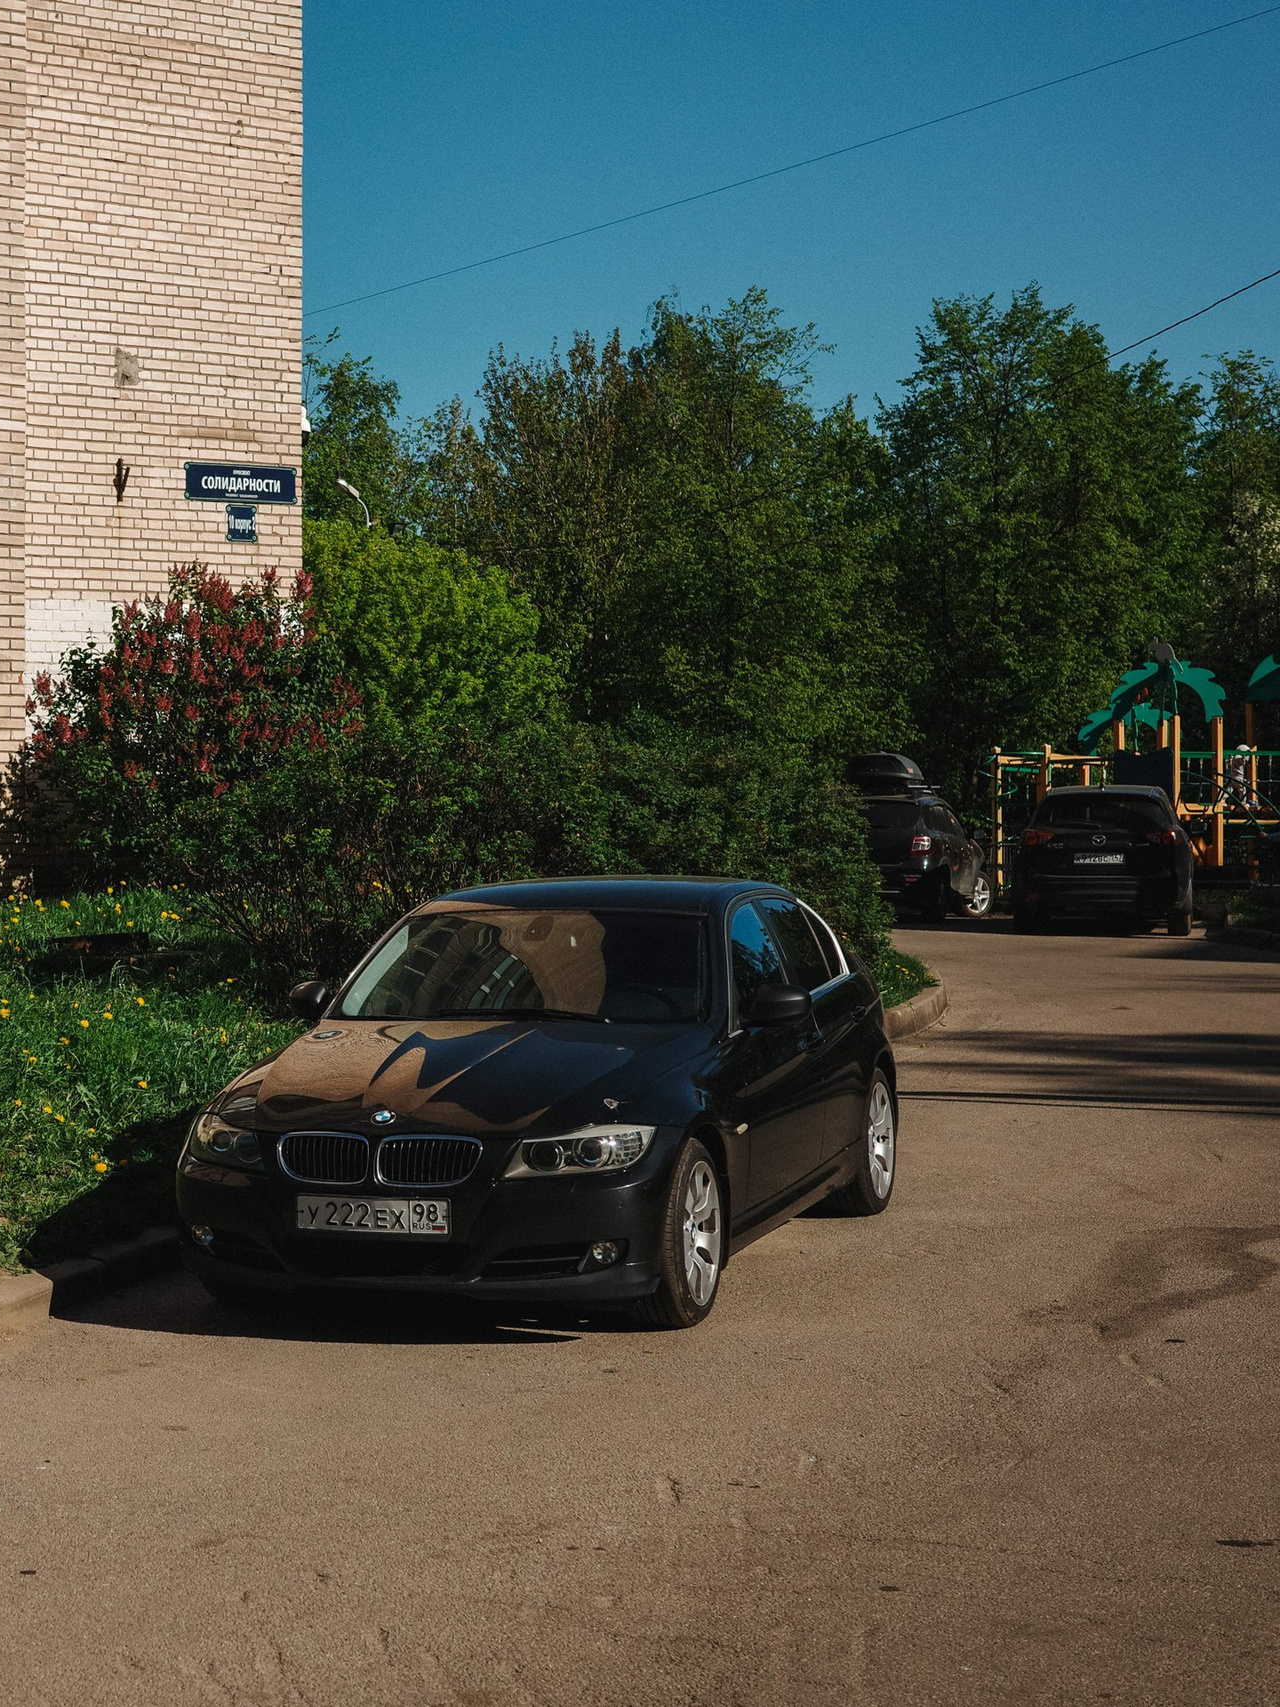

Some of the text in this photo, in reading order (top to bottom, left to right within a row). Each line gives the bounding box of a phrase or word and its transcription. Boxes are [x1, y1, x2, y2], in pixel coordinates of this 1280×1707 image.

[201, 476, 281, 493] СОЛИДАРНОСТИ
[413, 1203, 439, 1222] 98
[412, 1222, 432, 1231] RUS
